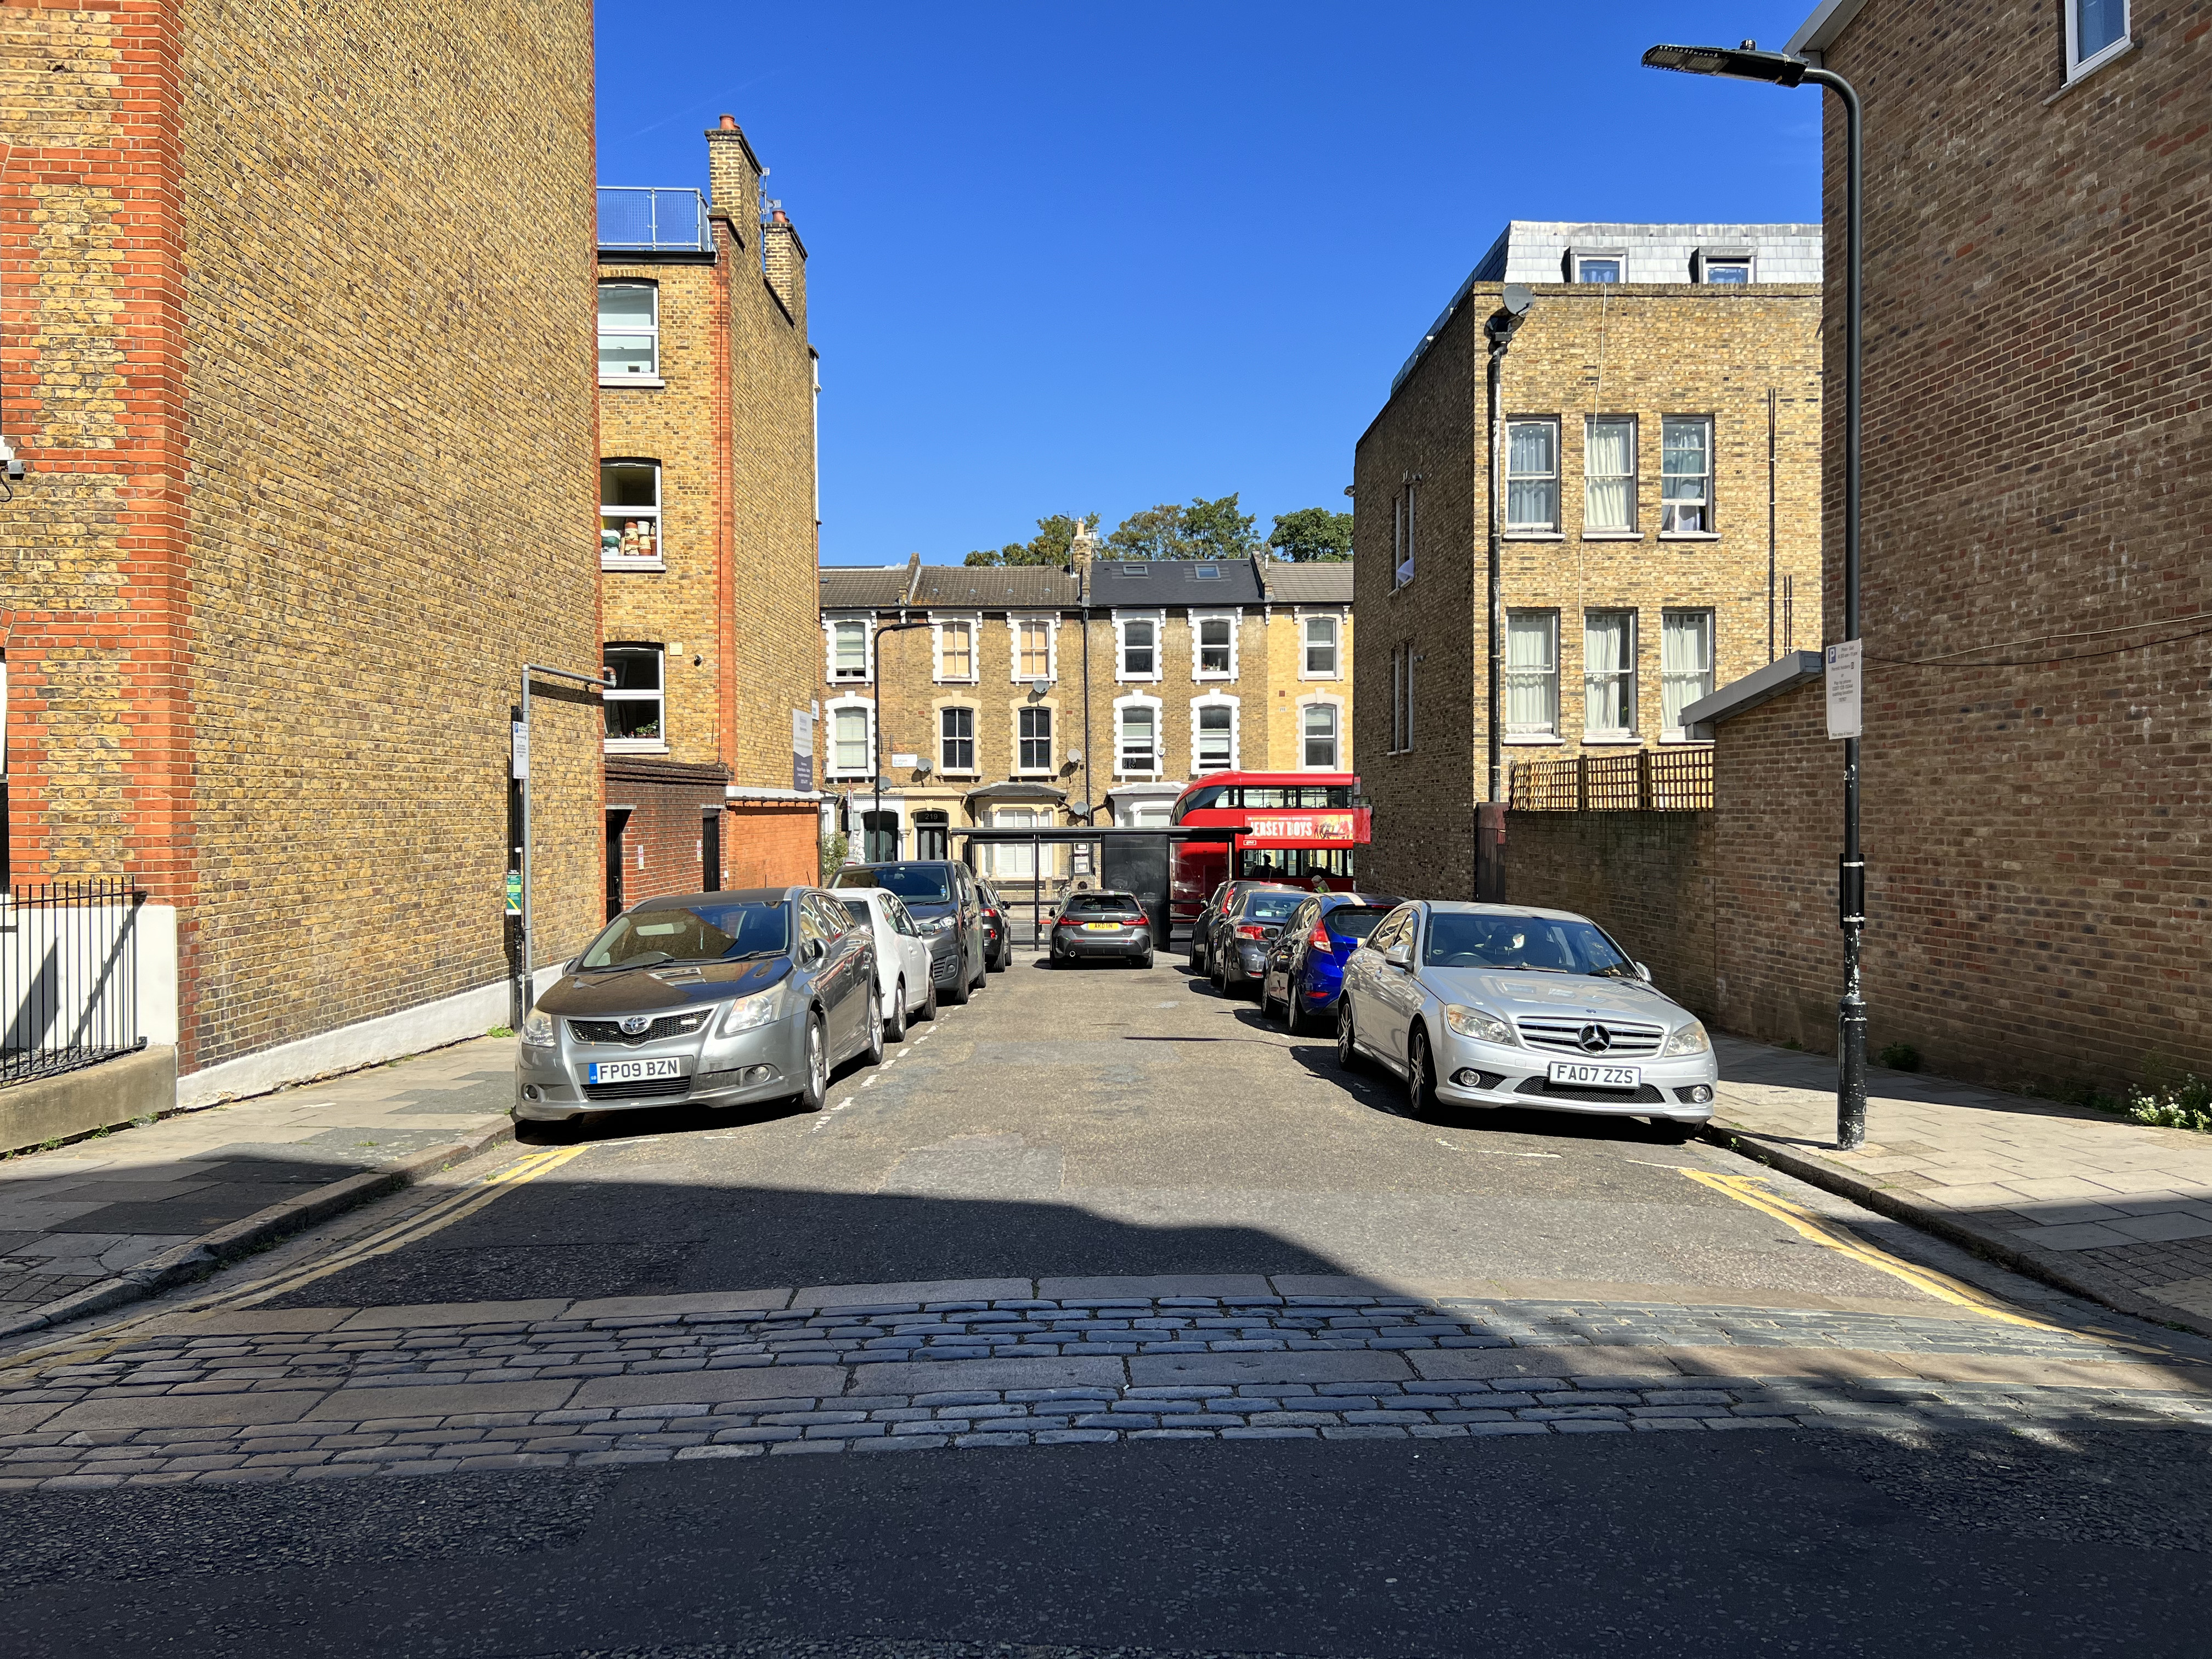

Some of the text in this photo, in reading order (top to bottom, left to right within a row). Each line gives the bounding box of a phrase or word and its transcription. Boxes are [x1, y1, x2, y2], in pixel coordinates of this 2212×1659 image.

[1830, 648, 1835, 663] P
[1249, 821, 1313, 837] JERSEY BOYS
[600, 1059, 678, 1080] FP09 BZN
[1557, 1064, 1633, 1084] FA07 ZZS
